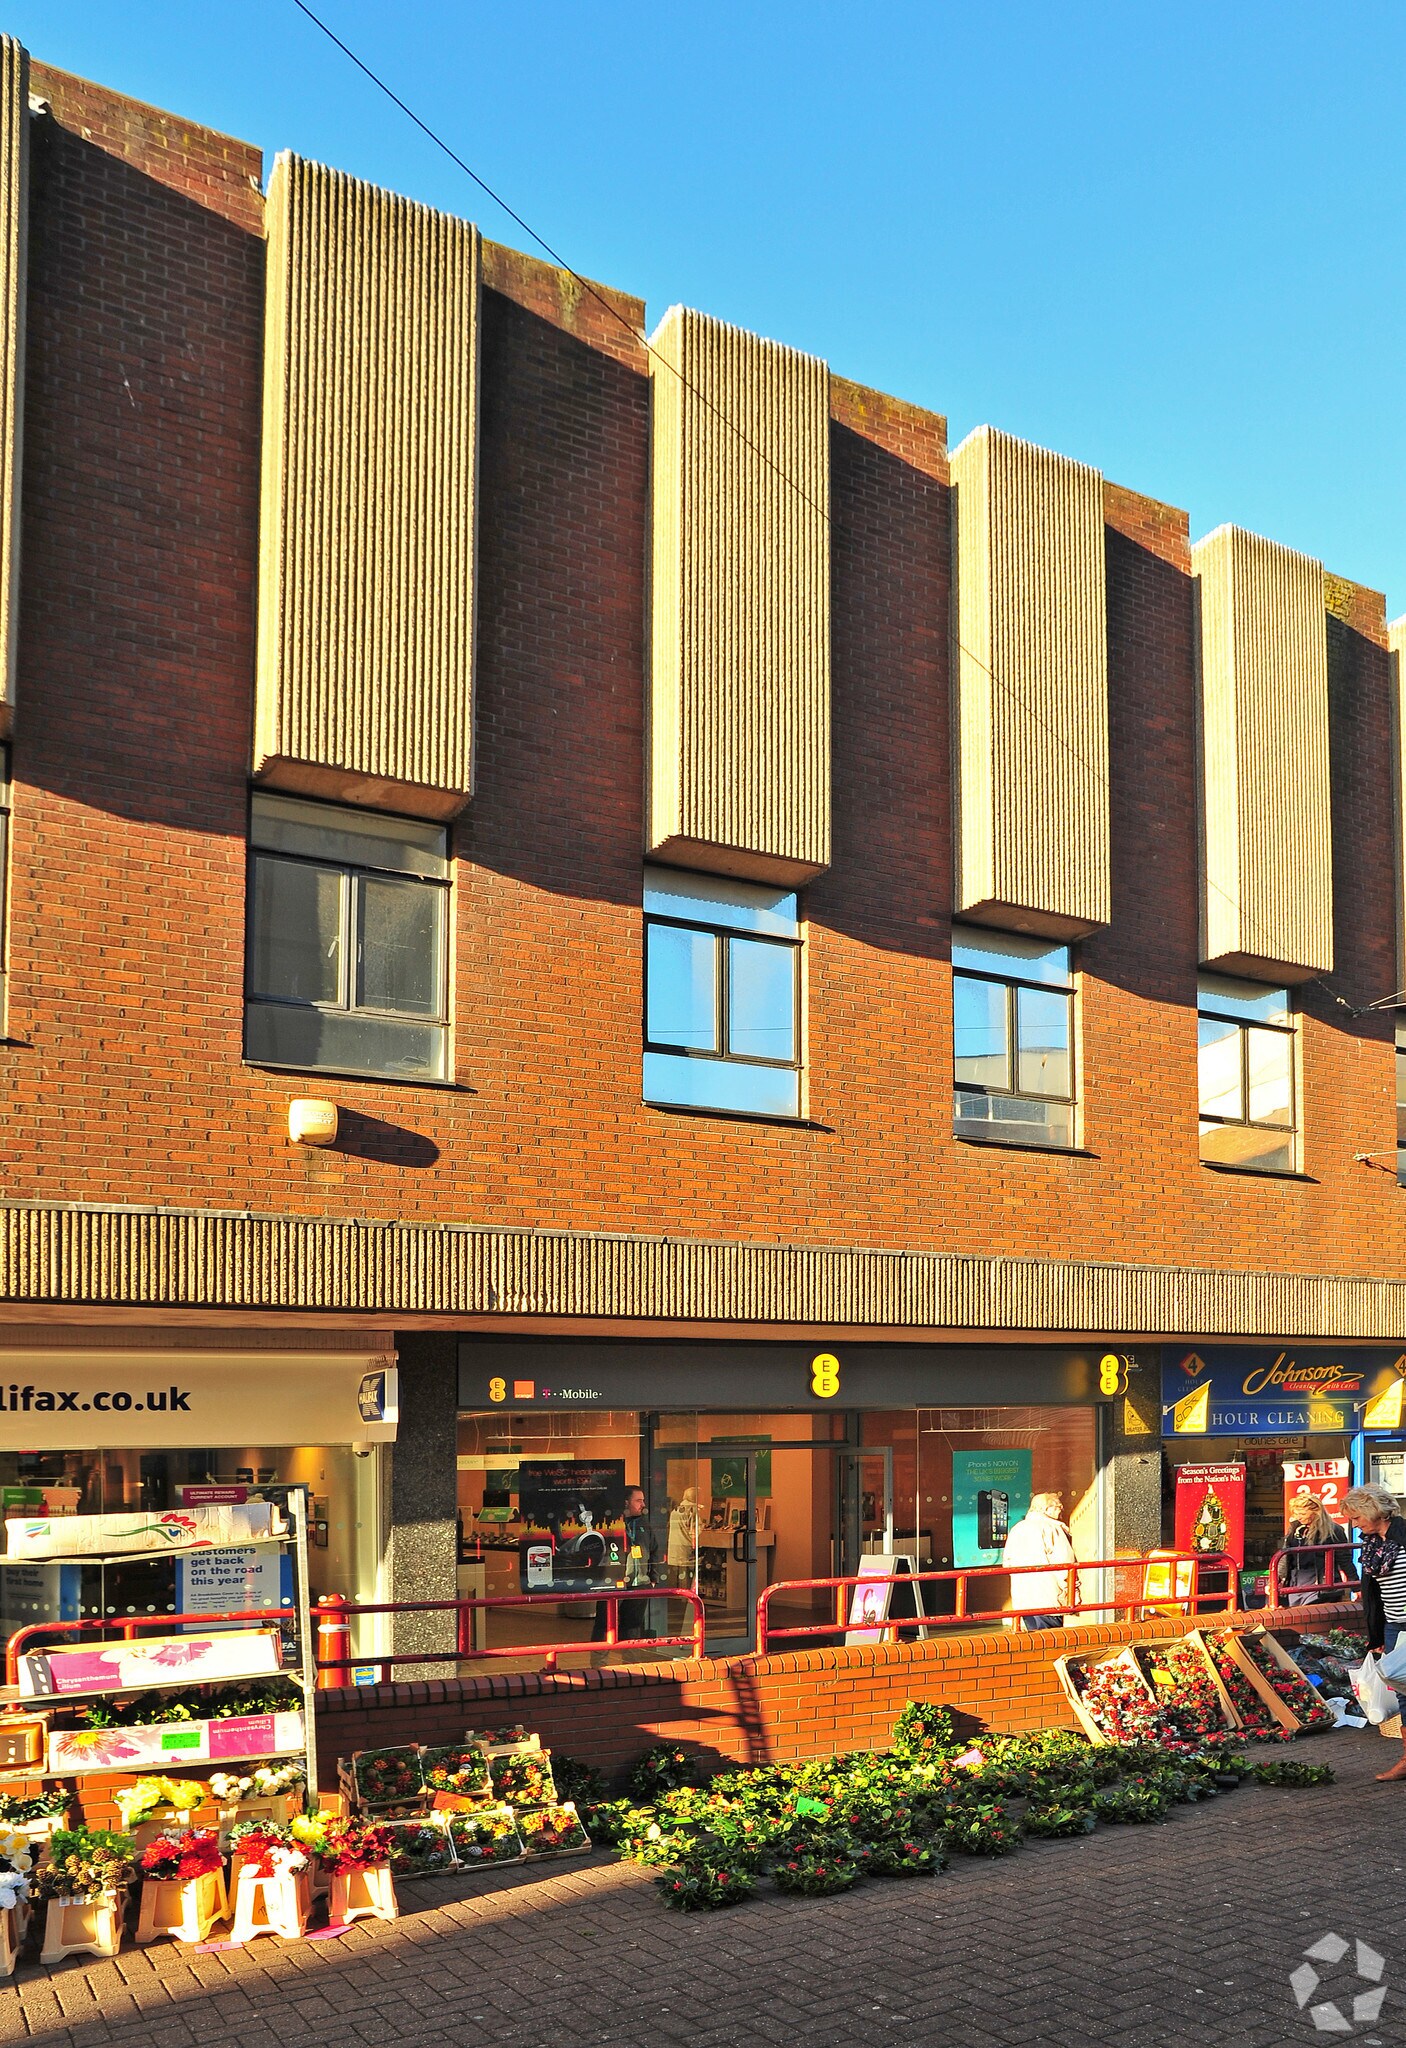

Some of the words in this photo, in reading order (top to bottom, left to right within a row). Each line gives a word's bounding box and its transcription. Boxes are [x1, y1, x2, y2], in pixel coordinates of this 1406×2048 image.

[1187, 1357, 1198, 1374] 4
[1242, 1352, 1364, 1395] Johnsons
[1340, 1381, 1356, 1389] Care
[1212, 1412, 1259, 1425] HOUR
[1267, 1411, 1345, 1425] CLEANING
[1278, 1436, 1298, 1444] care
[571, 1468, 617, 1476] headphones
[1181, 1467, 1209, 1475] Season's
[1209, 1466, 1240, 1475] Greetings
[1294, 1461, 1338, 1479] SALE!
[553, 1477, 573, 1485] worth
[1177, 1476, 1193, 1484] from
[1204, 1475, 1229, 1483] Nation's
[1321, 1482, 1338, 1505] 2
[190, 1547, 257, 1556] customers
[190, 1557, 211, 1567] get
[215, 1556, 245, 1565] back
[210, 1567, 230, 1575] the
[235, 1565, 263, 1574] road
[190, 1577, 214, 1585] this
[218, 1577, 245, 1586] year
[56, 1674, 118, 1684] Chrysanthemum
[212, 1724, 272, 1734] Chrysanthemum
